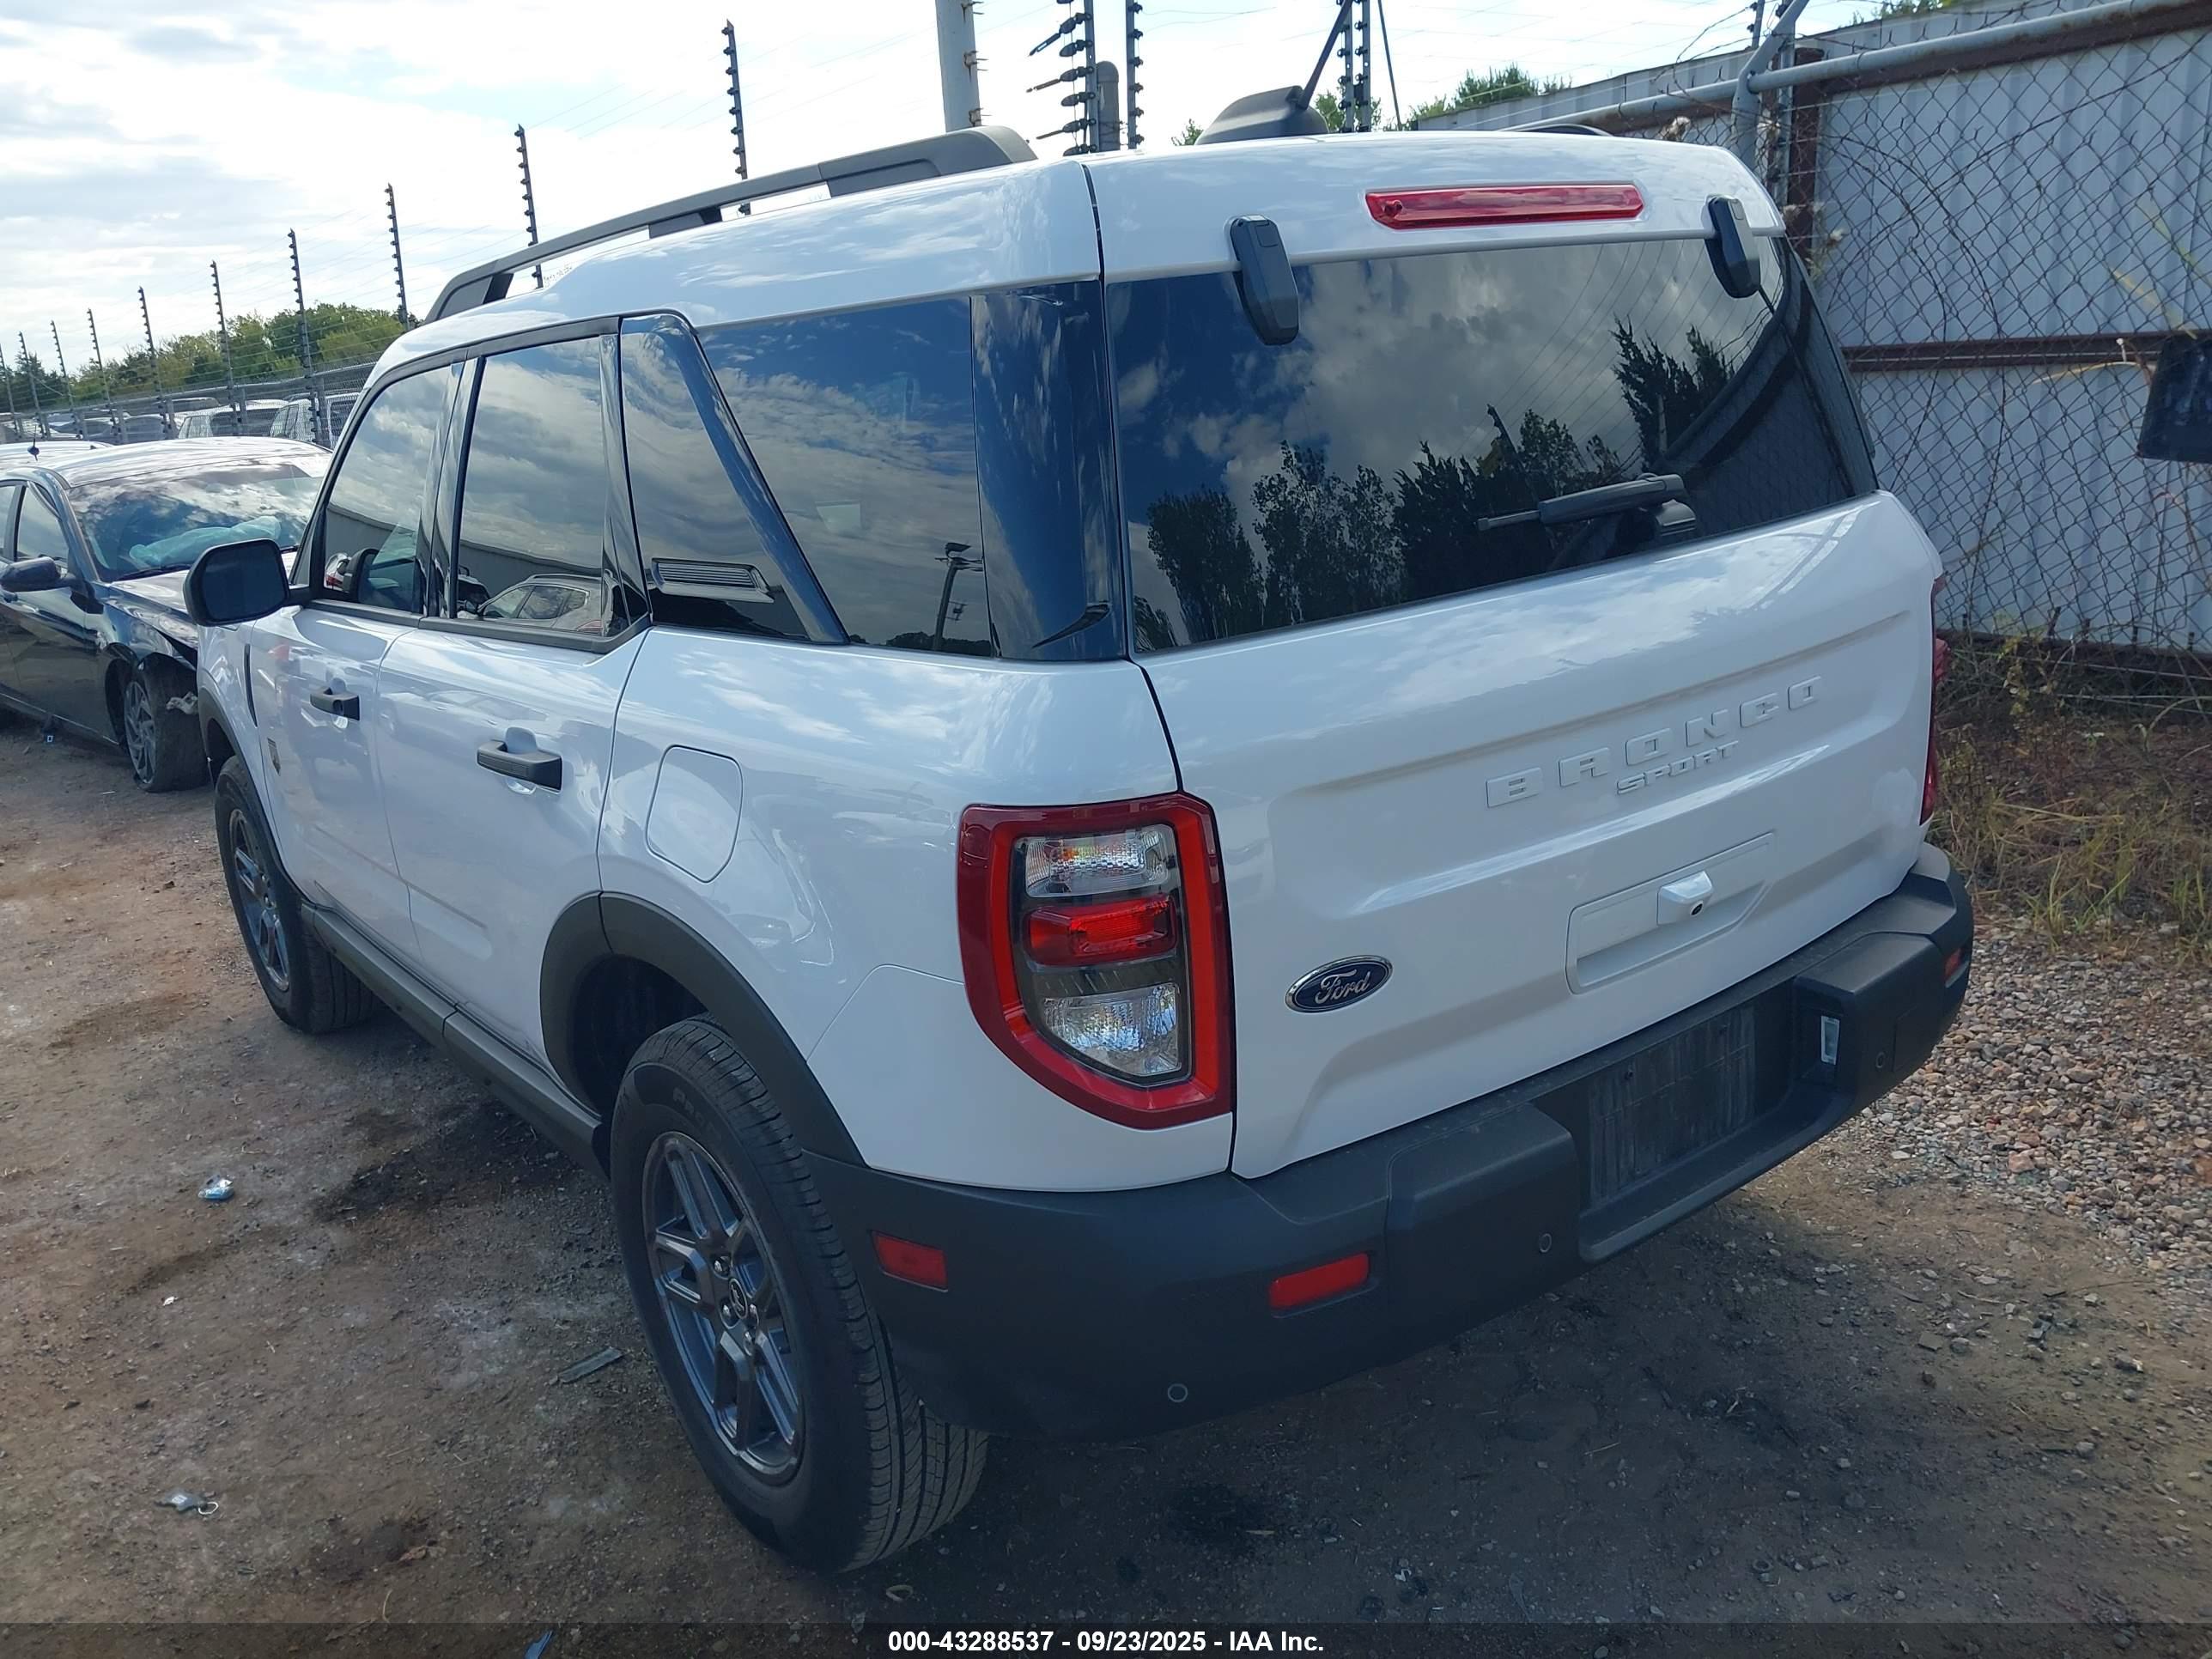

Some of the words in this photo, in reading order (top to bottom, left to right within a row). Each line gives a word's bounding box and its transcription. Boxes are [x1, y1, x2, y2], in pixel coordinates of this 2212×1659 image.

[1485, 675, 1822, 808] BRONCO
[1615, 739, 1739, 795] SPORT
[1315, 969, 1371, 1005] Ford
